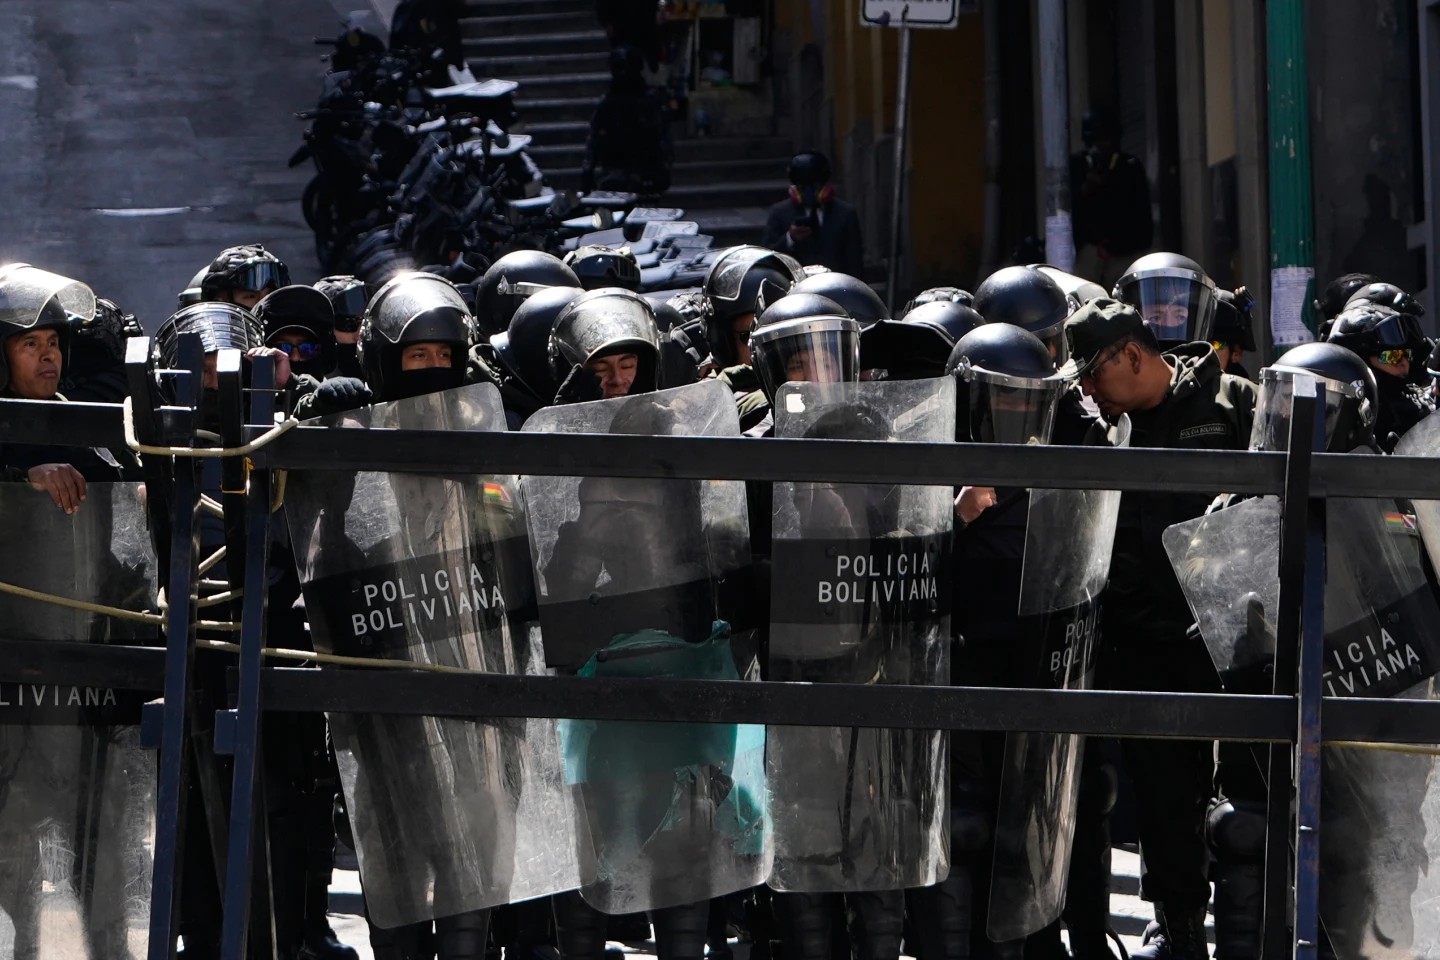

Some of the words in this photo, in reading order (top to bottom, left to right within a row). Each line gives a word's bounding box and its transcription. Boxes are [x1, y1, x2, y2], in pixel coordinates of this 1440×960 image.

[837, 552, 930, 577] POLICIA
[363, 562, 484, 607] POLICIA
[819, 577, 937, 603] BOLIVIANA
[351, 585, 505, 636] BOLIVIANA
